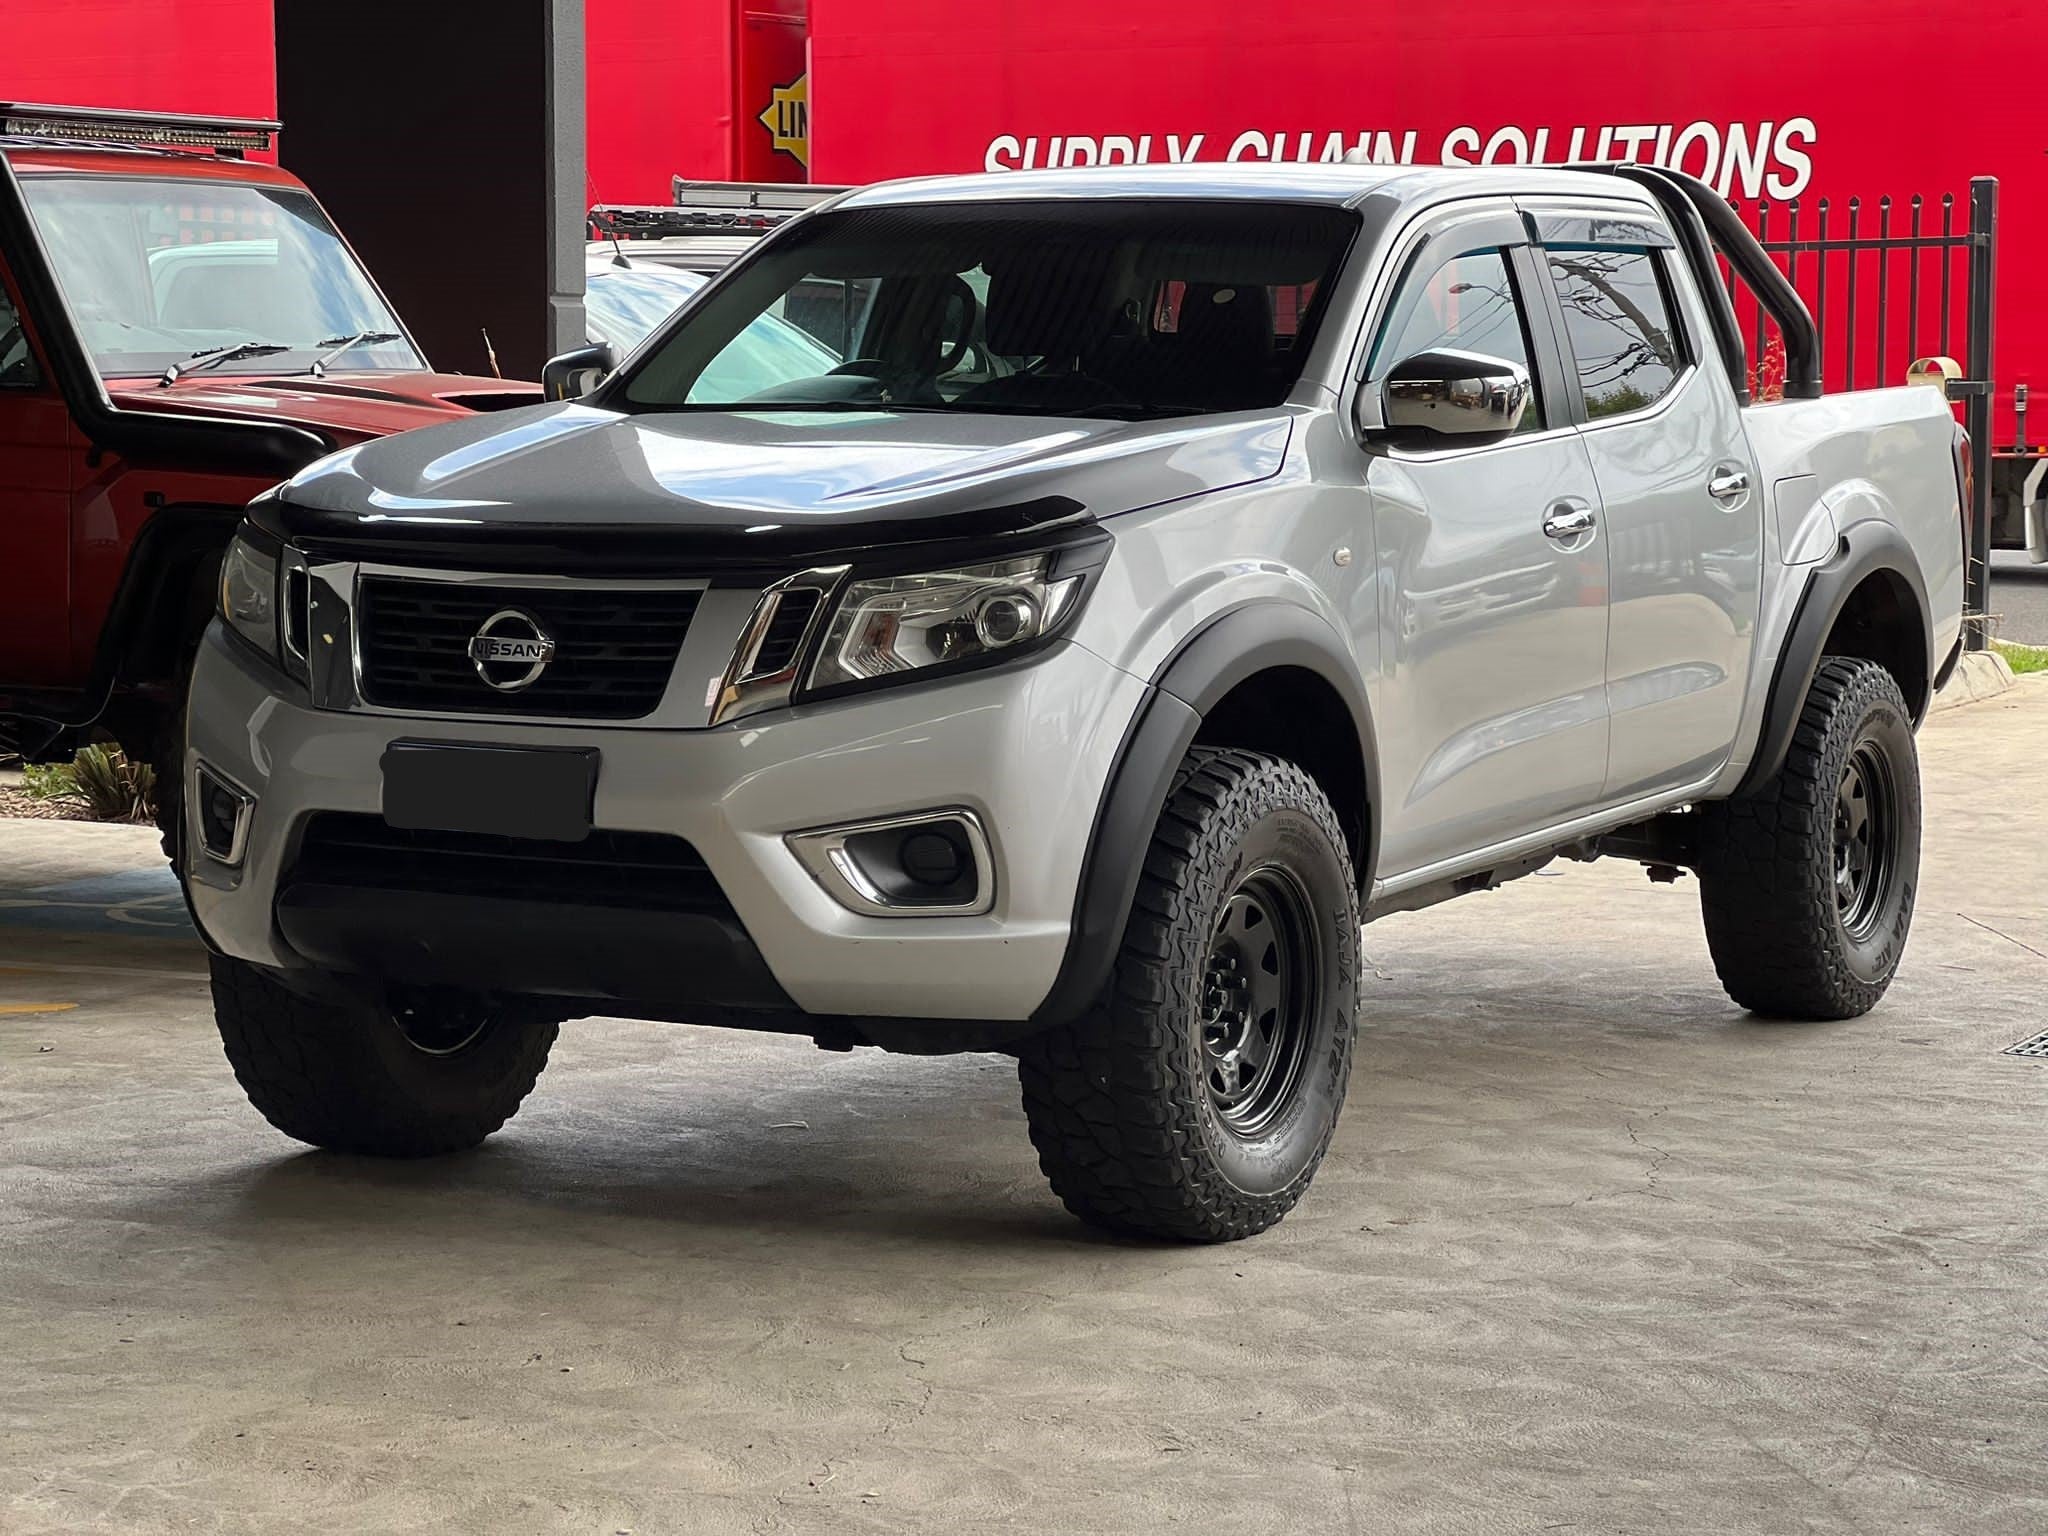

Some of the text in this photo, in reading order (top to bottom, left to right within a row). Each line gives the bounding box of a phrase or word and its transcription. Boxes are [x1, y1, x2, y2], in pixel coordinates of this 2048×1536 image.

[1226, 129, 1418, 165] CHAN
[1440, 116, 1818, 201] SOLUTIONS
[475, 641, 541, 657] NISSAN
